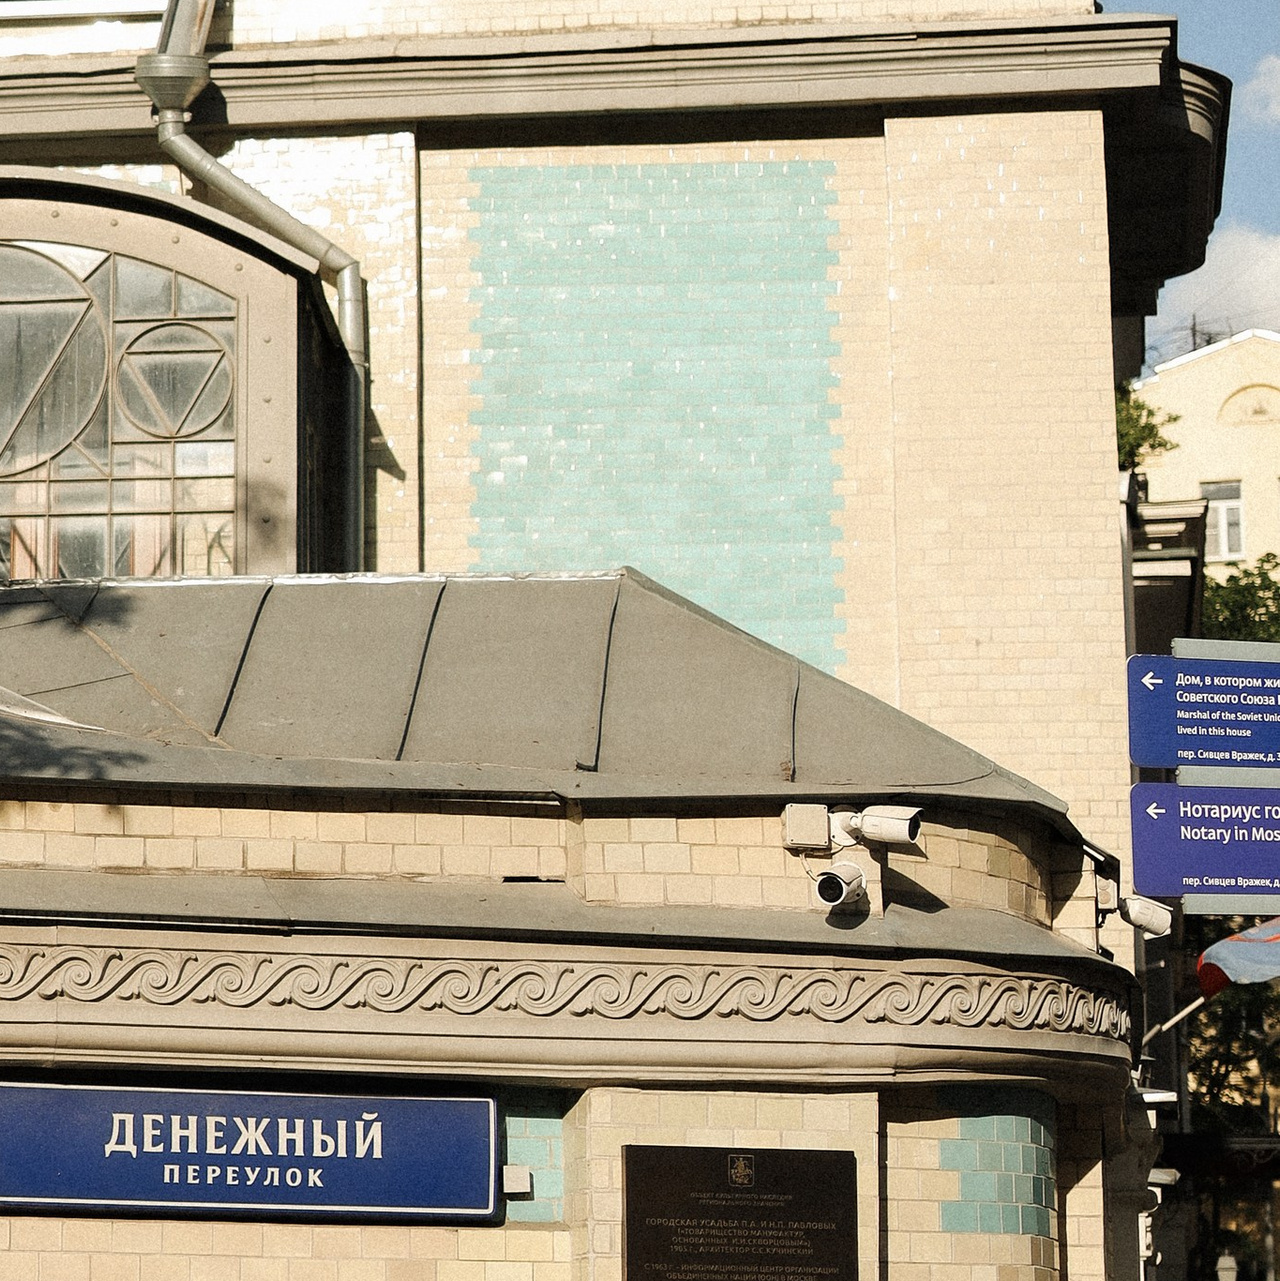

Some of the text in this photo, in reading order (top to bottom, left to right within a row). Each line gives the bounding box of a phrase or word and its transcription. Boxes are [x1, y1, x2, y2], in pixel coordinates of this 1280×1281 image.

[1175, 673, 1203, 687] Дом,
[1205, 676, 1212, 686] в
[1213, 677, 1262, 690] котором
[1176, 690, 1239, 704] Советского
[1240, 693, 1275, 705] Союза
[1176, 710, 1210, 720] Marshal
[1211, 711, 1220, 720] of
[1221, 711, 1236, 721] the
[1237, 712, 1263, 722] Soviet
[1177, 725, 1252, 737] lived in this house
[1177, 750, 1196, 761] пер.
[1197, 749, 1230, 761] Сивцев
[1231, 750, 1266, 762] Вражек,
[1179, 801, 1261, 823] Нотариус
[1180, 825, 1231, 844] Notary
[1234, 825, 1248, 841] in
[1182, 877, 1202, 887] пер.
[1203, 876, 1236, 887] Сивцев
[1237, 876, 1272, 888] Вражек,
[104, 1112, 384, 1159] ДЕНЕЖНЫЙ
[163, 1164, 325, 1188] ПЕРЕУЛОК
[646, 1218, 698, 1227] ГОРОДСКАЯ
[700, 1219, 739, 1228] УСАДЬБА
[788, 1221, 836, 1230] ПАВЛОВЫХ
